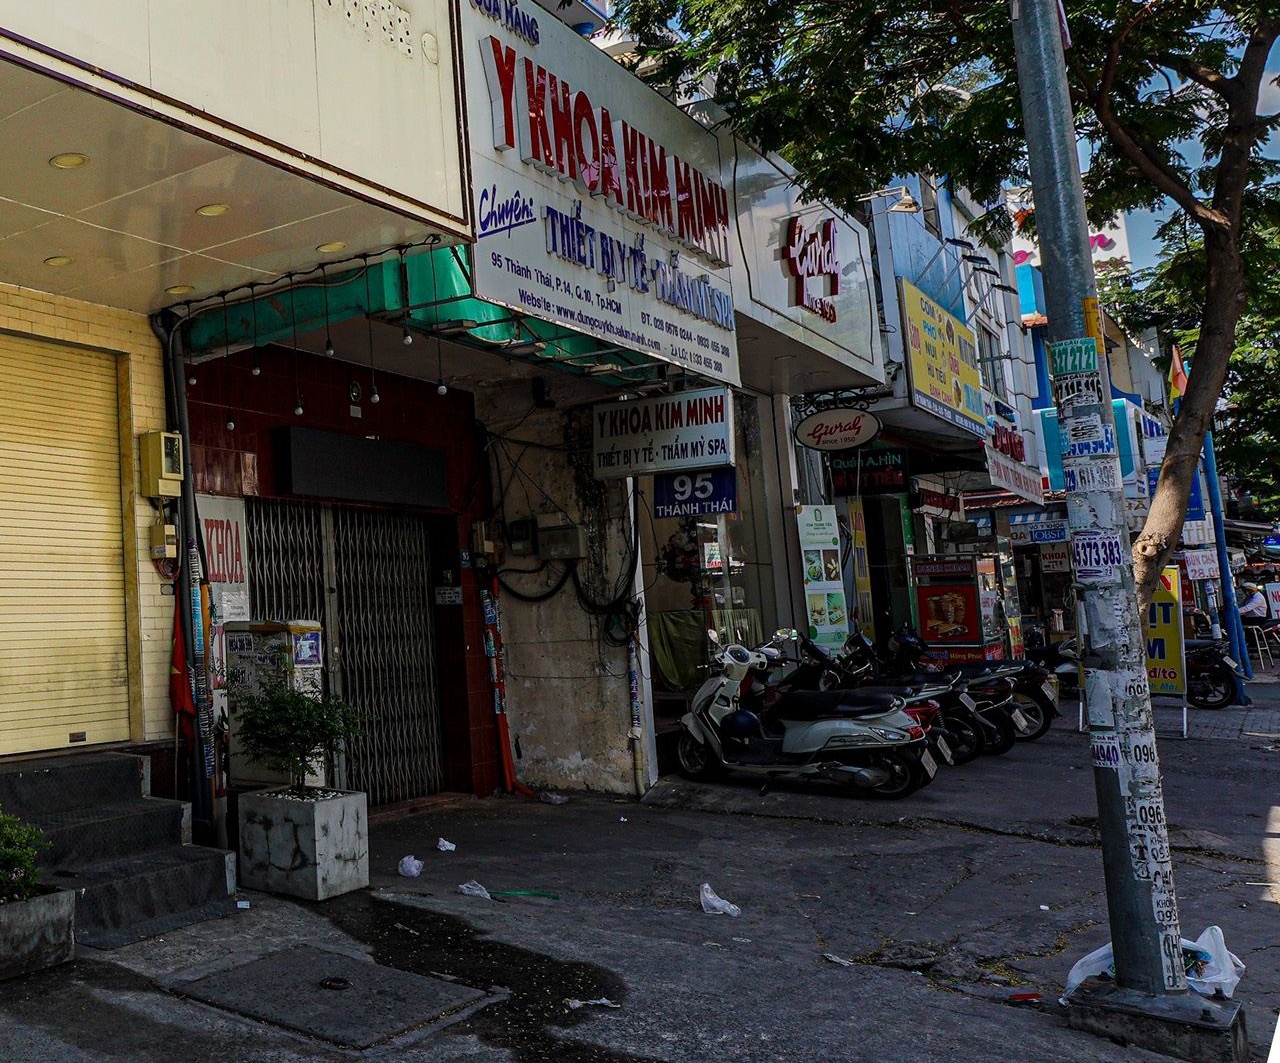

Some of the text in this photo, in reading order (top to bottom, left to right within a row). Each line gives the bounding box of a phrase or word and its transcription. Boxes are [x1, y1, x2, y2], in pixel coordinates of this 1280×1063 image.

[485, 34, 730, 268] Y KHOA KIM MINH
[491, 252, 502, 269] 95
[505, 257, 531, 281] Thành
[544, 200, 596, 269] THIẾT
[713, 288, 736, 331] SPA
[598, 395, 724, 438] Y KHOA KIM MINH
[597, 443, 621, 467] THIẾT
[624, 450, 631, 469] BỊ
[633, 448, 641, 464] Y
[642, 439, 654, 463] TẾ
[661, 435, 688, 460] THẨM
[707, 438, 726, 456] SPA
[673, 473, 714, 501] 95
[657, 497, 732, 517] THÀNH THÁI
[204, 519, 245, 585] KHOA
[1042, 552, 1067, 560] KHOA
[1149, 602, 1174, 629] ỊT
